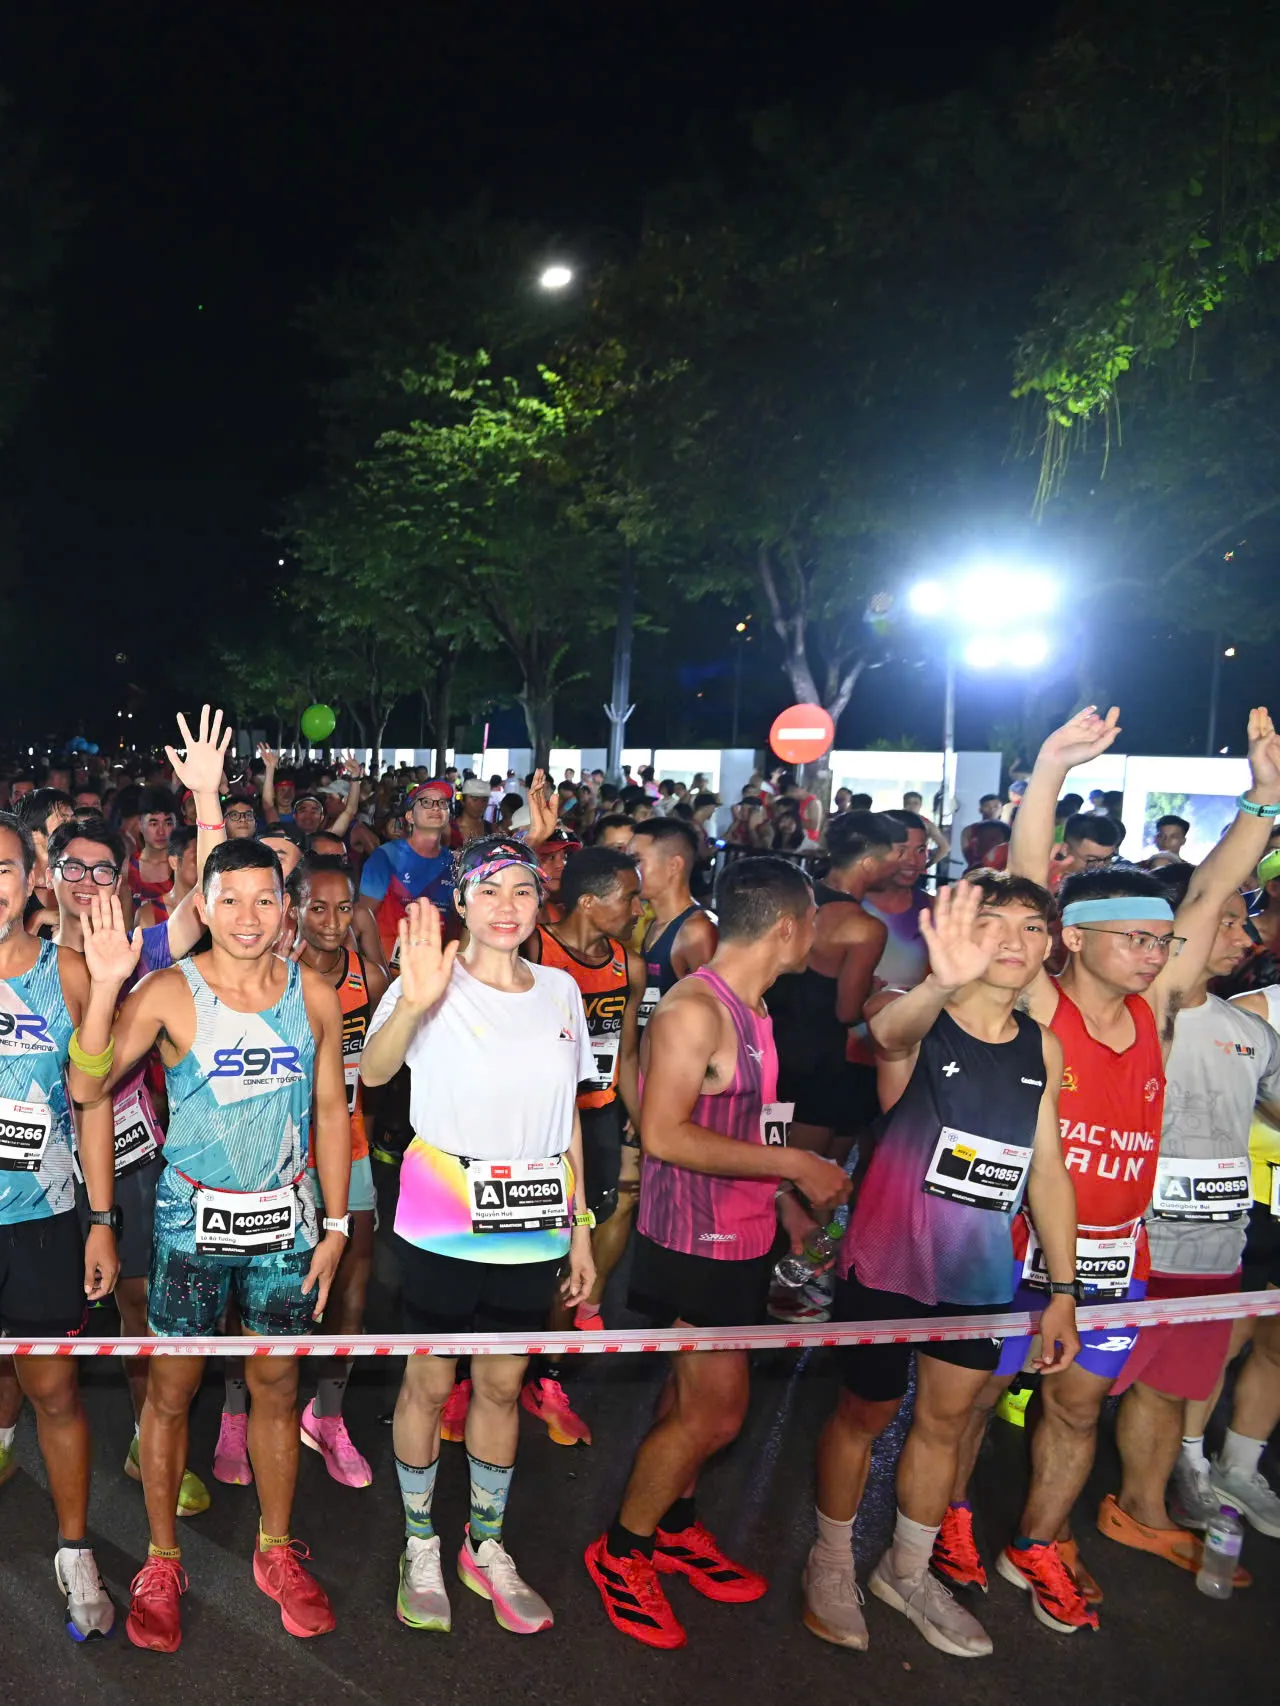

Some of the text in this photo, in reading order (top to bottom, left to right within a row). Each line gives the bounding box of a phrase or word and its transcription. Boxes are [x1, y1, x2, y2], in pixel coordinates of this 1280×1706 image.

[20, 1042, 31, 1050] TO
[206, 1045, 302, 1078] S9R
[243, 1077, 274, 1086] CONNECT
[115, 1125, 145, 1152] 0441
[768, 1126, 781, 1145] A
[975, 1163, 1020, 1182] 401855
[1064, 1146, 1145, 1182] RUN
[479, 1183, 559, 1206] A 401260
[1164, 1179, 1247, 1198] A 400859
[206, 1210, 290, 1231] A 400264
